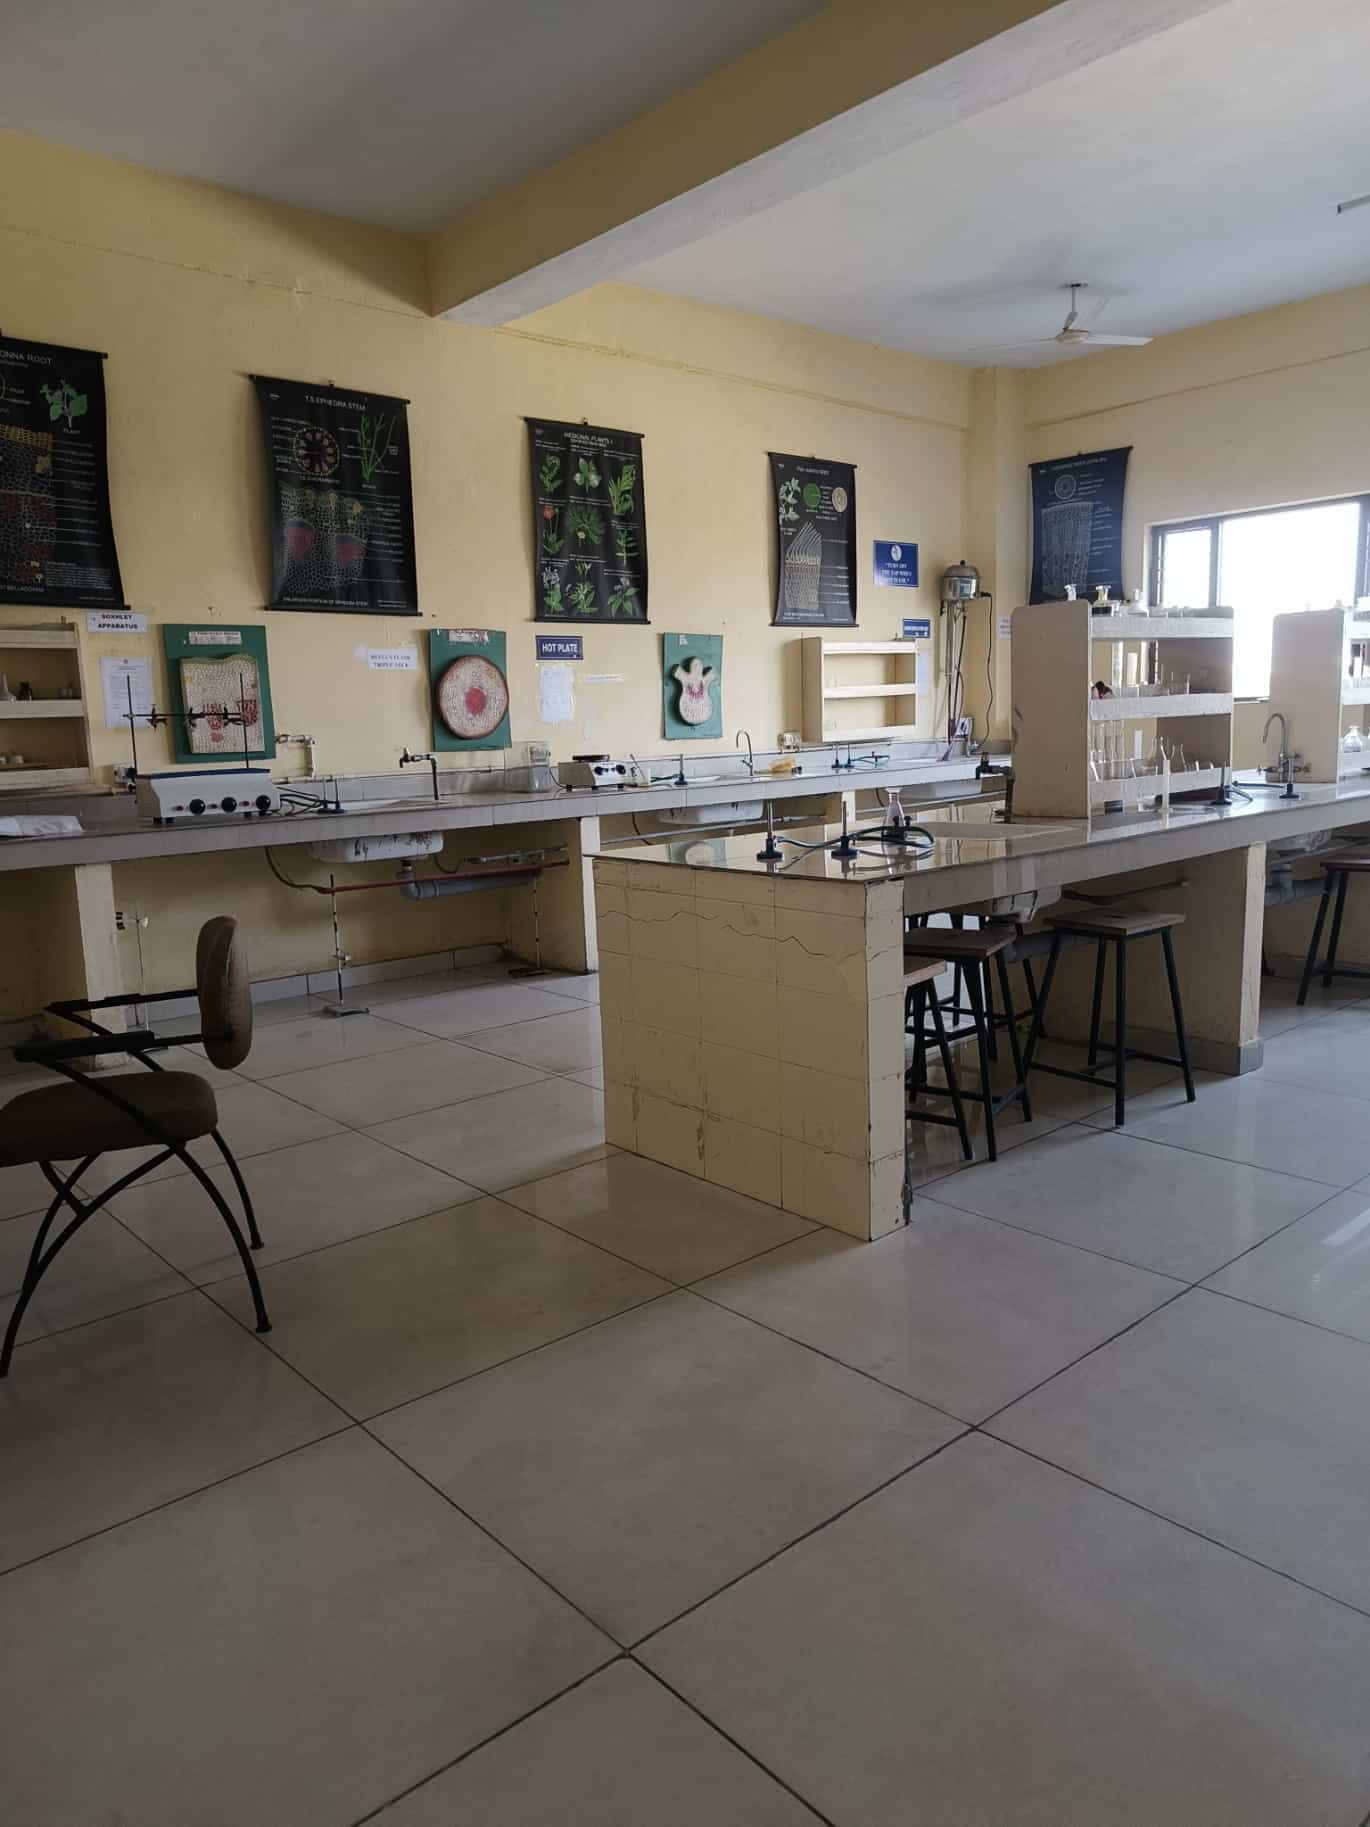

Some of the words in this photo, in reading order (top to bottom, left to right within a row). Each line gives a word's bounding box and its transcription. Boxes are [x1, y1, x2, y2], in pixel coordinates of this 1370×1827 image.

[98, 622, 138, 630] APPARATUS
[542, 643, 557, 653] HOT
[557, 643, 578, 653] PLATE
